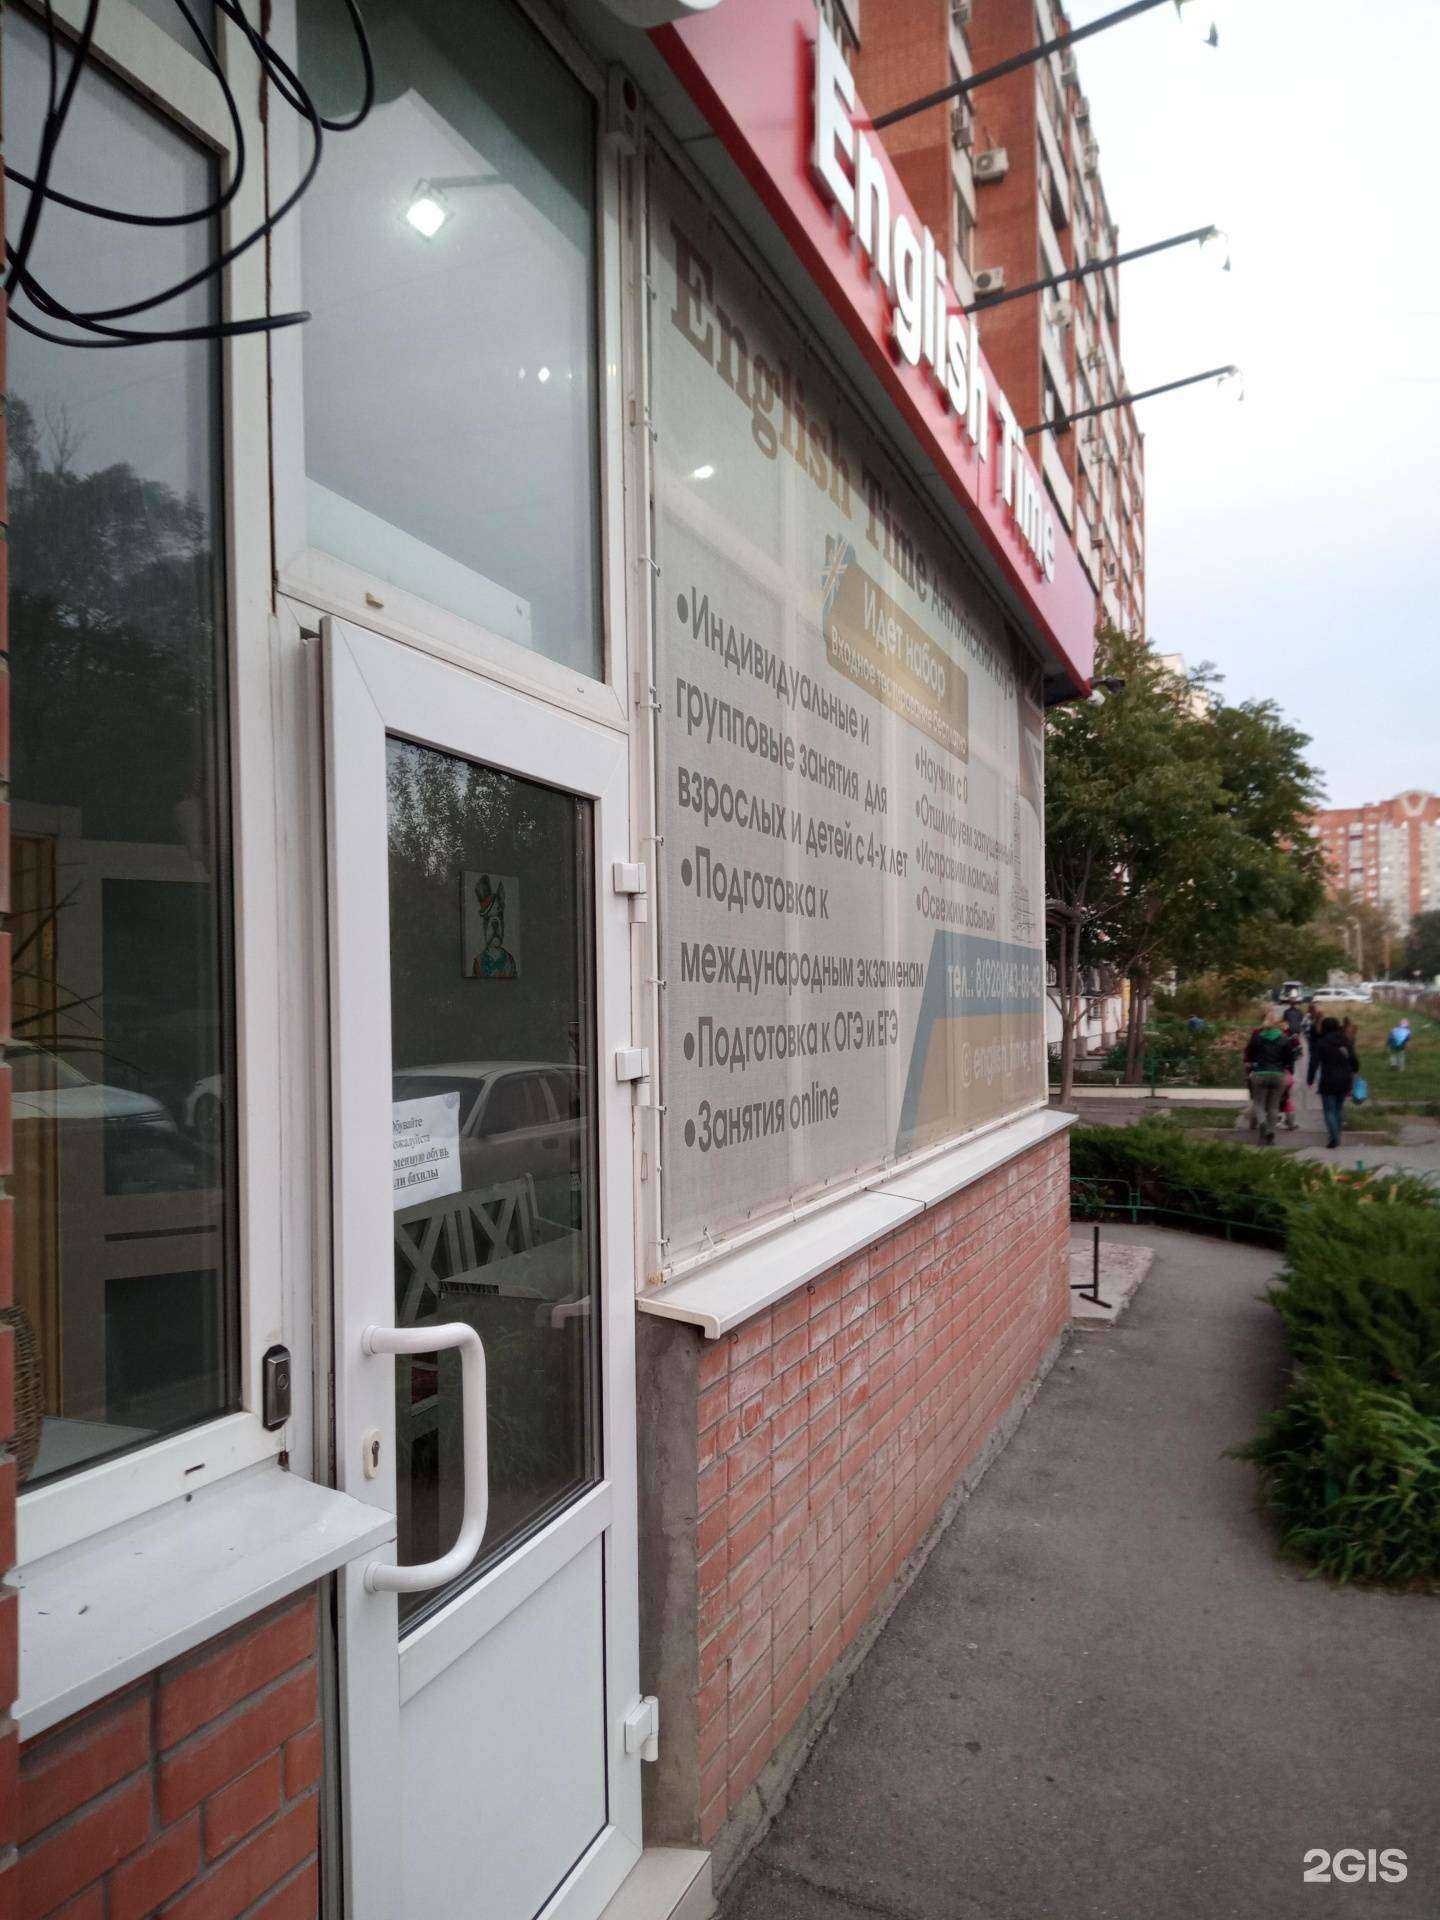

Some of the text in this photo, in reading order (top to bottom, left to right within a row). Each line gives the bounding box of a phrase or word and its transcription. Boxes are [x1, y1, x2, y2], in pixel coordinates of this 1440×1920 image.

[815, 14, 1055, 584] English Time
[671, 216, 928, 602] English Time
[691, 586, 870, 746] Индивидуальные и
[831, 624, 875, 686] Входное
[864, 581, 945, 701] Идет набор
[676, 677, 888, 815] групповые занятия для
[920, 746, 955, 794] Научим
[678, 766, 908, 878] взрослых и детей с 4-х лет
[920, 793, 972, 847] Отшлифуем
[695, 846, 829, 920] Подготовка к
[920, 839, 966, 887] Исправим
[921, 886, 964, 925] Освежим
[681, 942, 924, 996] международным экзаменам
[698, 1009, 899, 1074] Подготовка к ОГЭ и ЕГЭ
[698, 1080, 839, 1153] Занятия online
